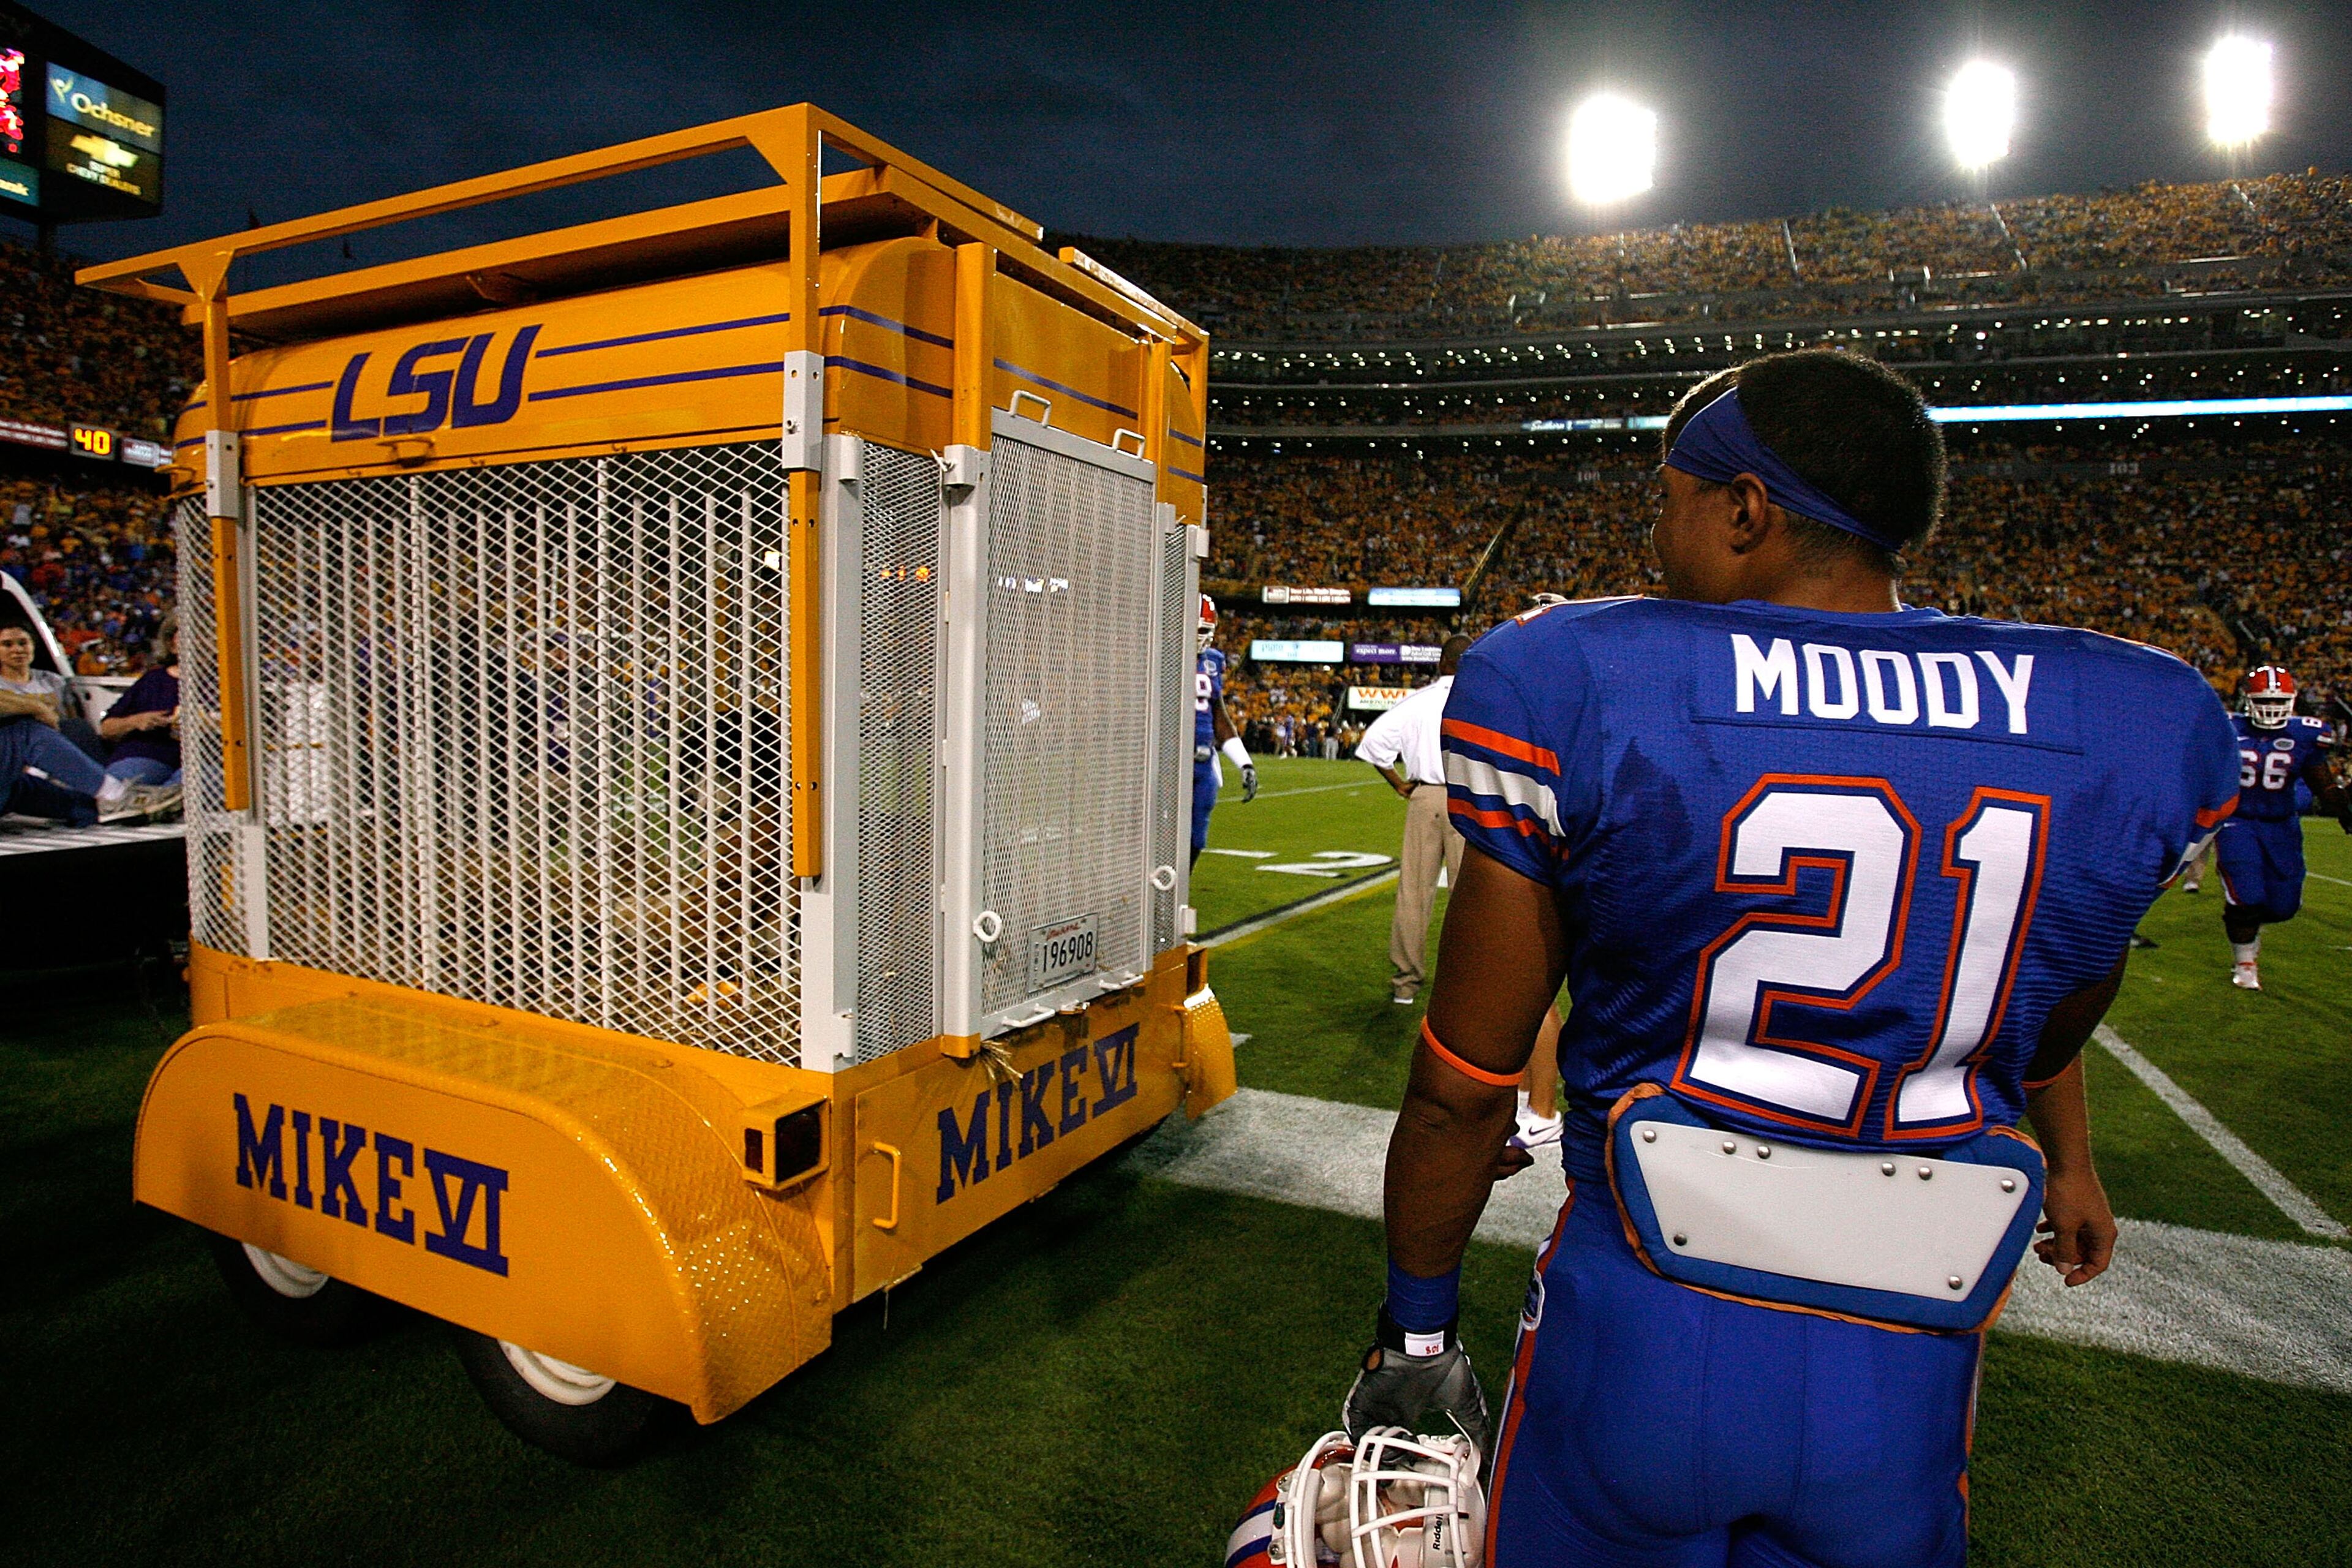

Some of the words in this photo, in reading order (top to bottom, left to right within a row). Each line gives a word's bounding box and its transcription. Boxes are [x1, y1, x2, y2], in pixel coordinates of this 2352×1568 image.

[70, 92, 155, 137] Ochsner
[331, 323, 544, 442] LSU
[74, 428, 112, 456] 40
[1730, 633, 2035, 734] MOODY
[2239, 750, 2292, 790] 66
[1043, 931, 1093, 973] 196908
[1671, 772, 2051, 1140] 21
[936, 1044, 1088, 1205] MIKE
[1092, 1022, 1140, 1119] VI
[233, 1092, 415, 1245] MIKE
[423, 1148, 509, 1278] VI
